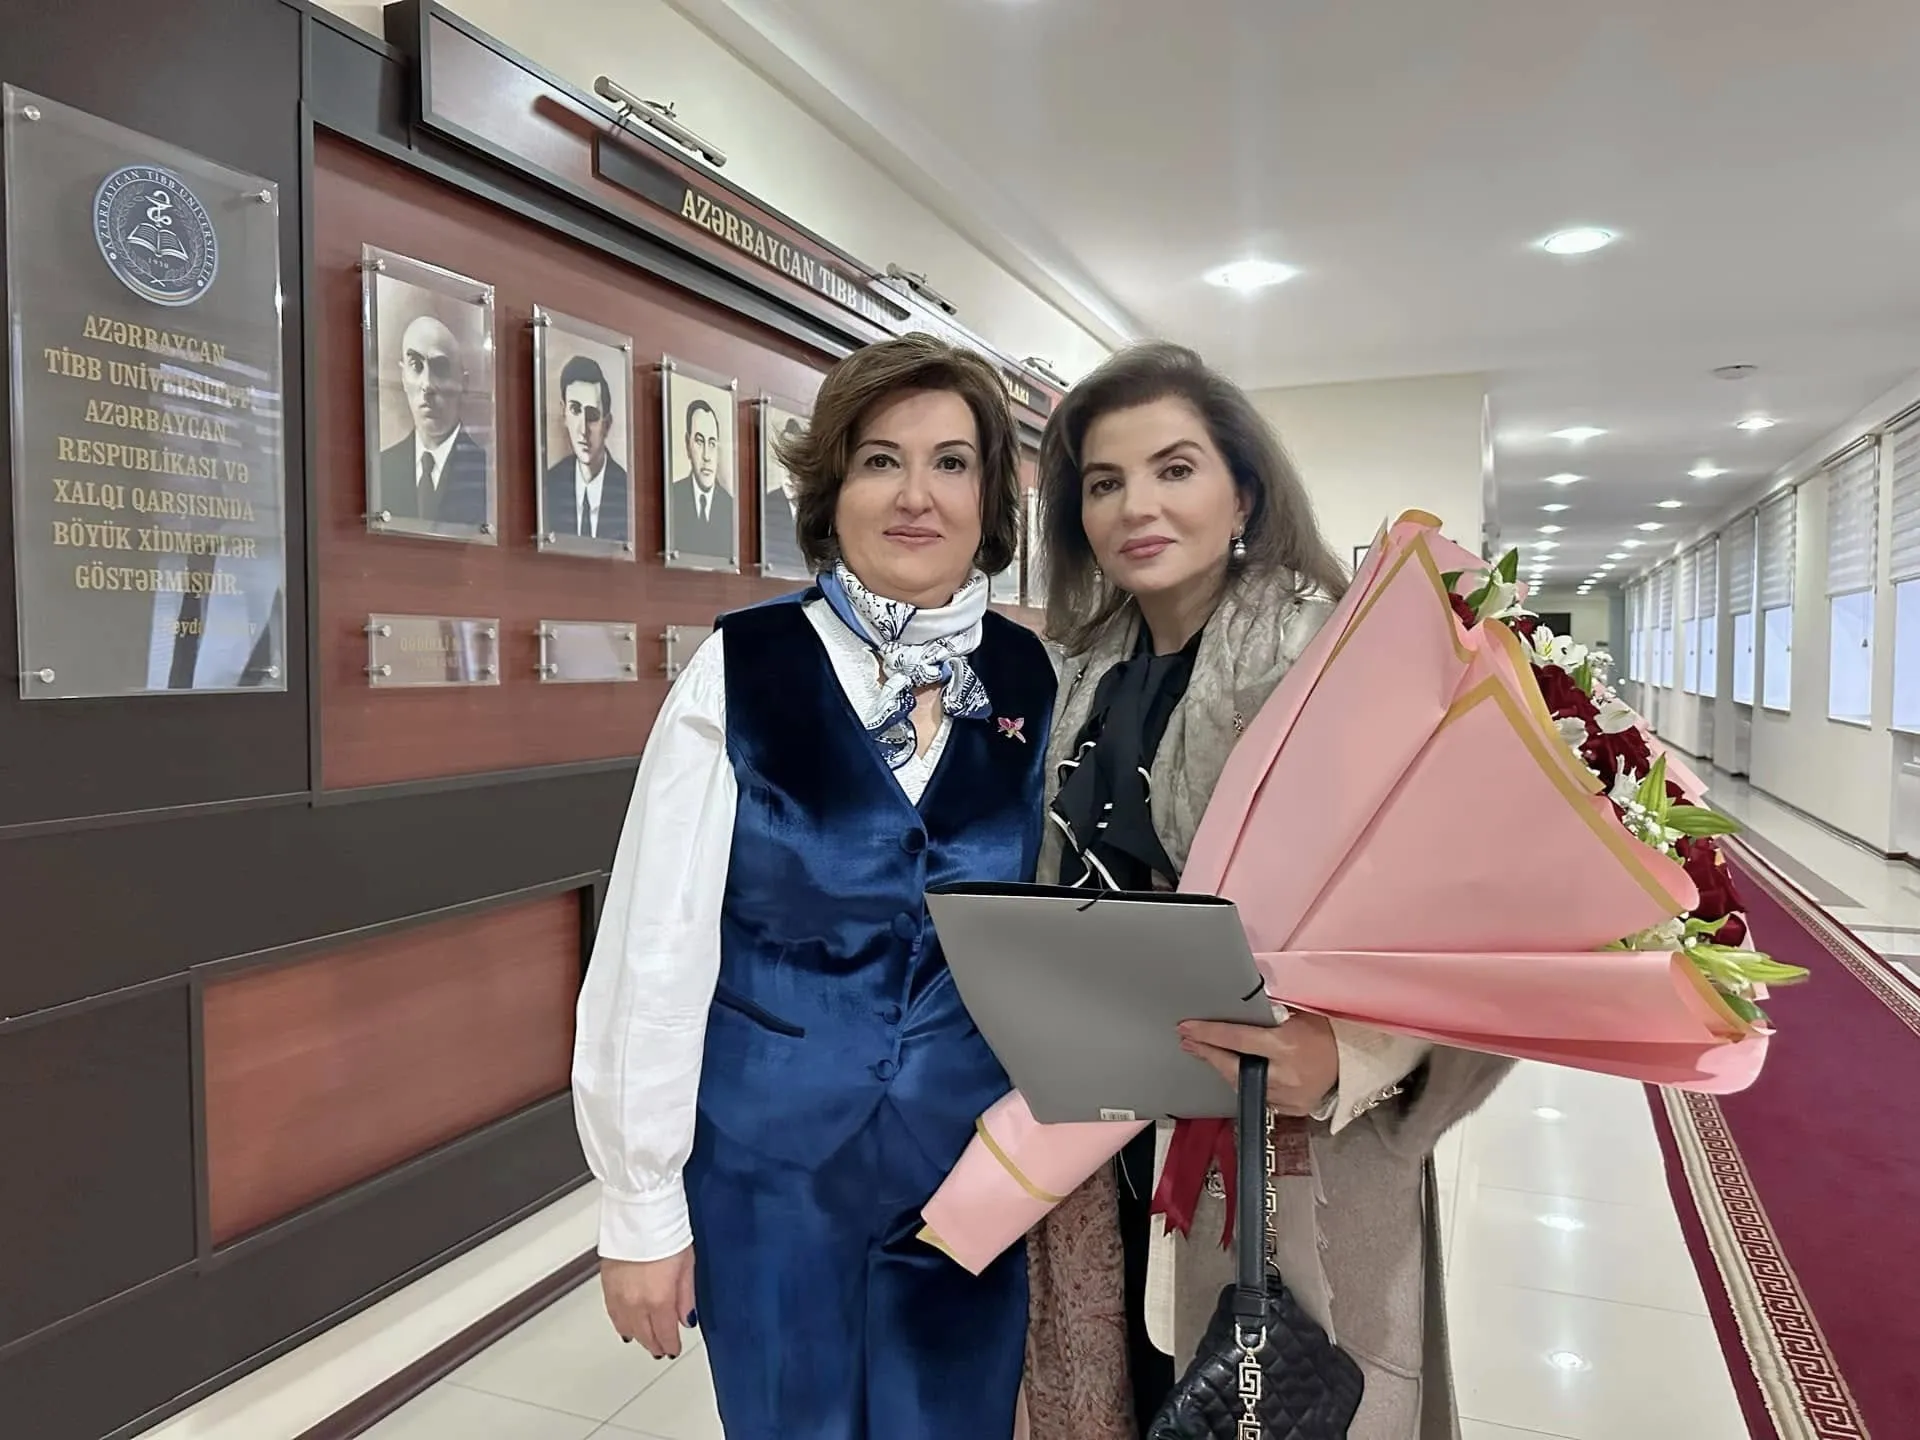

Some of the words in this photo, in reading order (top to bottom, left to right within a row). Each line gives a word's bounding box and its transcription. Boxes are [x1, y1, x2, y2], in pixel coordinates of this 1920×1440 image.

[681, 188, 814, 286] AZƏRBAYCAN
[819, 266, 857, 308] TİBB
[83, 315, 226, 366] AZƏRBAYCAN
[45, 346, 102, 382] TİBB
[85, 399, 227, 443] AZƏRBAYCAN
[57, 437, 218, 480] RESPUBLİKASI
[223, 460, 249, 484] VƏ
[53, 479, 125, 511] XALQI
[131, 487, 255, 522] QARŞISINDA
[53, 517, 133, 550] BÖYÜK
[138, 525, 257, 559] XİDMƏTLƏR
